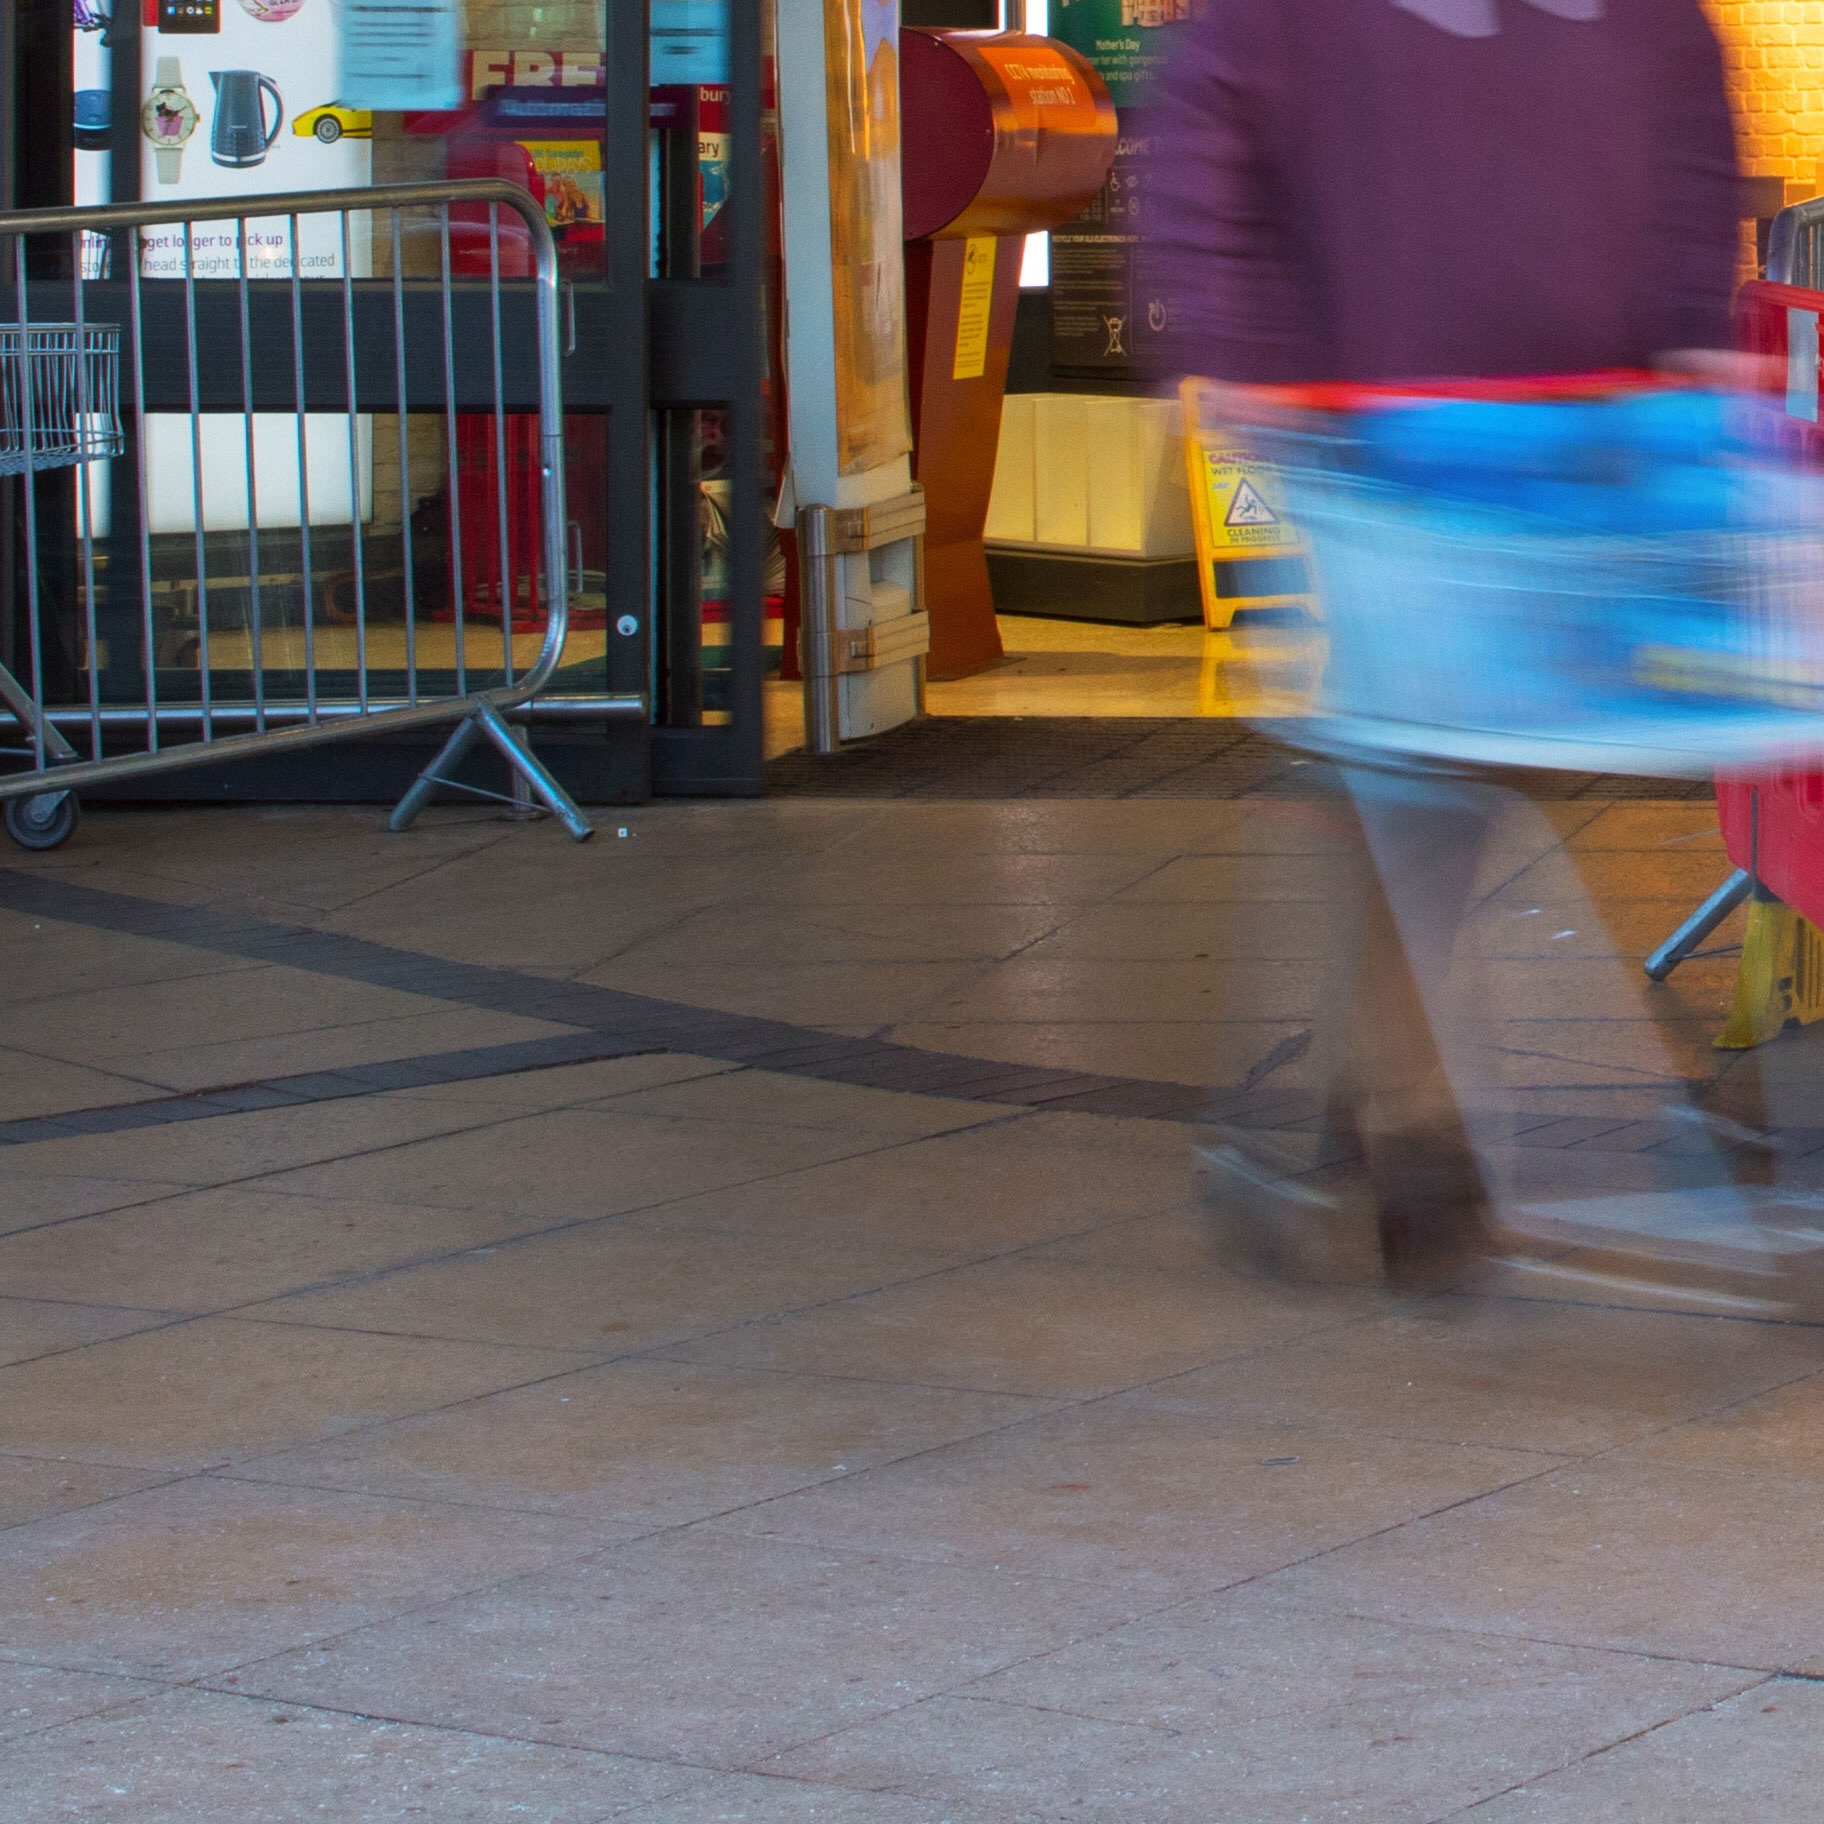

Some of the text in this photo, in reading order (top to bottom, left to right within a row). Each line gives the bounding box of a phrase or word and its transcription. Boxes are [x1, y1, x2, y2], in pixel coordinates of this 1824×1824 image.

[1096, 39, 1141, 53] Mother's Day
[1112, 54, 1127, 65] with
[1004, 64, 1076, 85] CCTV monitoring
[1029, 87, 1059, 105] station
[179, 234, 214, 250] loger
[219, 236, 232, 246] to
[266, 234, 283, 248] up
[144, 257, 177, 272] head
[180, 257, 230, 274] sraight
[250, 256, 271, 270] the
[1211, 467, 1233, 476] WET
[1227, 528, 1281, 537] CLEANING
[1230, 536, 1239, 544] IN
